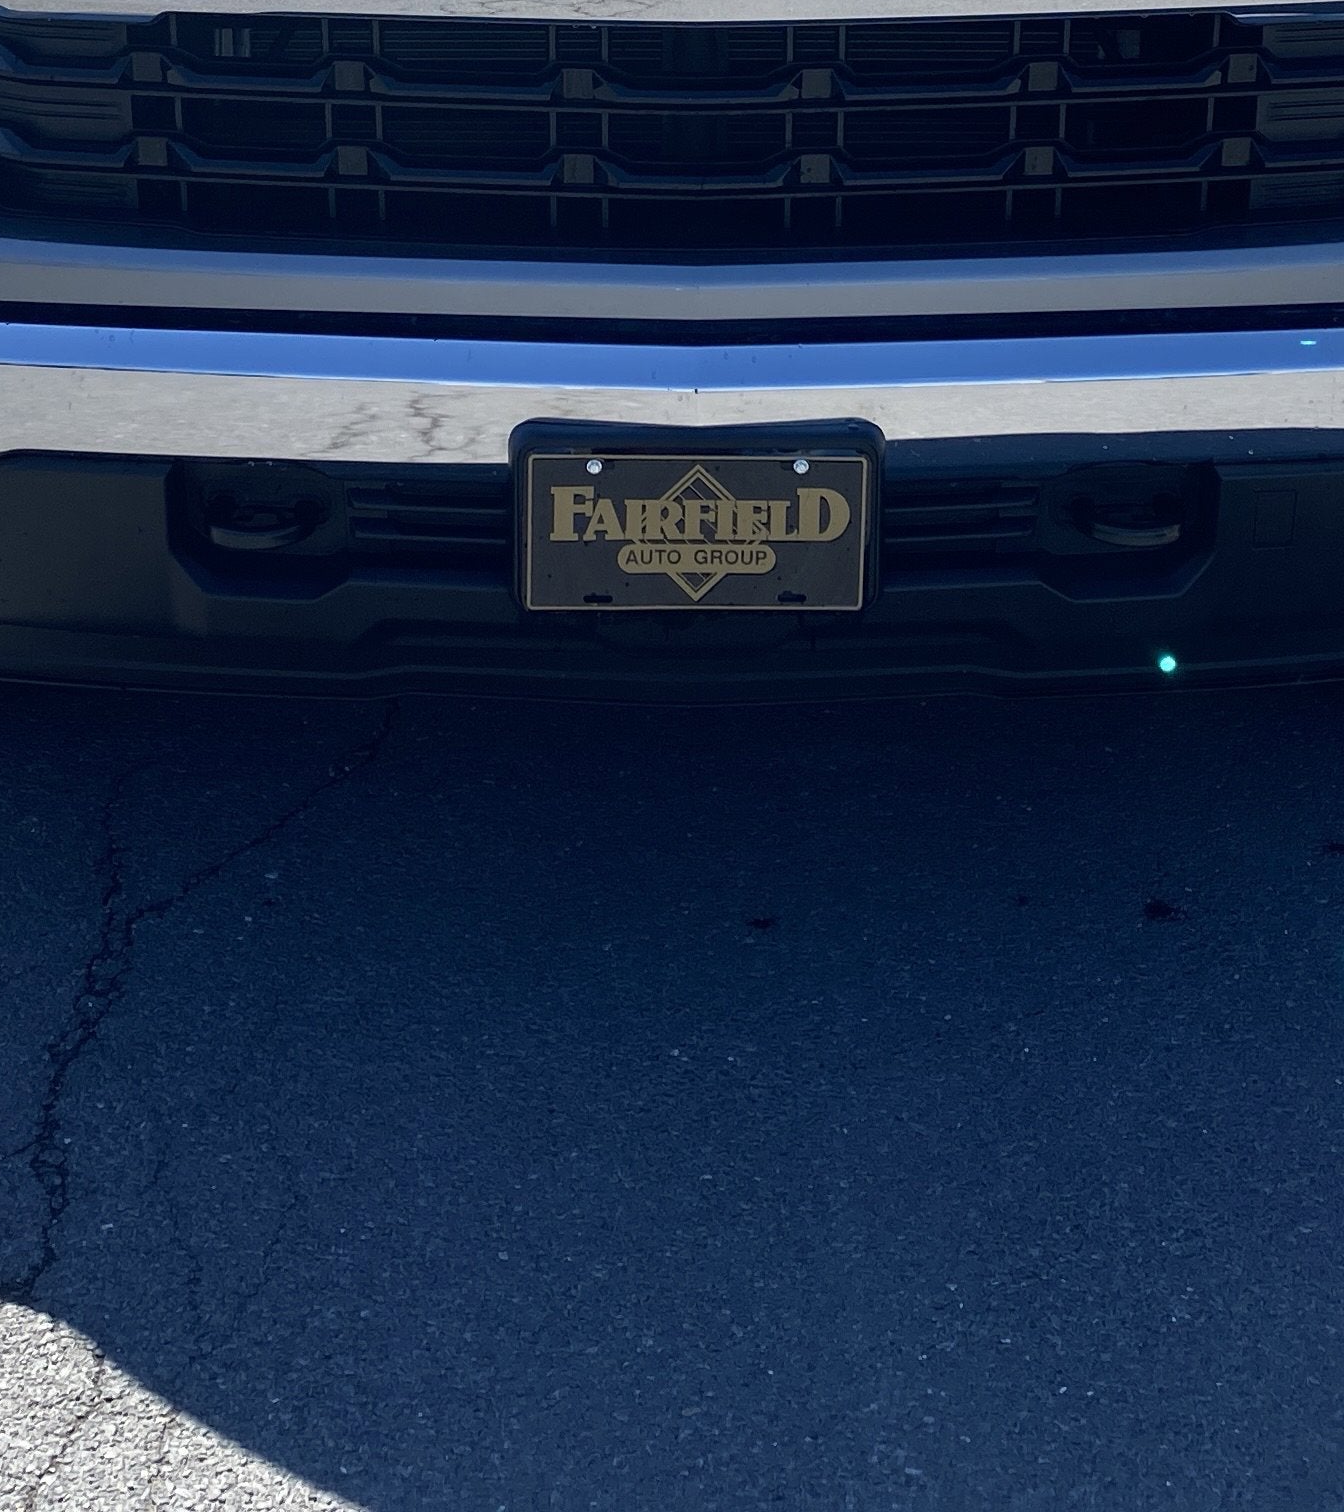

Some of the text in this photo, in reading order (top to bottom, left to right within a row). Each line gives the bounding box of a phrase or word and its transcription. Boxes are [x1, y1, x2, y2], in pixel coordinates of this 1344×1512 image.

[549, 485, 852, 542] FAIRFIELD
[624, 549, 768, 567] AUTO GROUP
